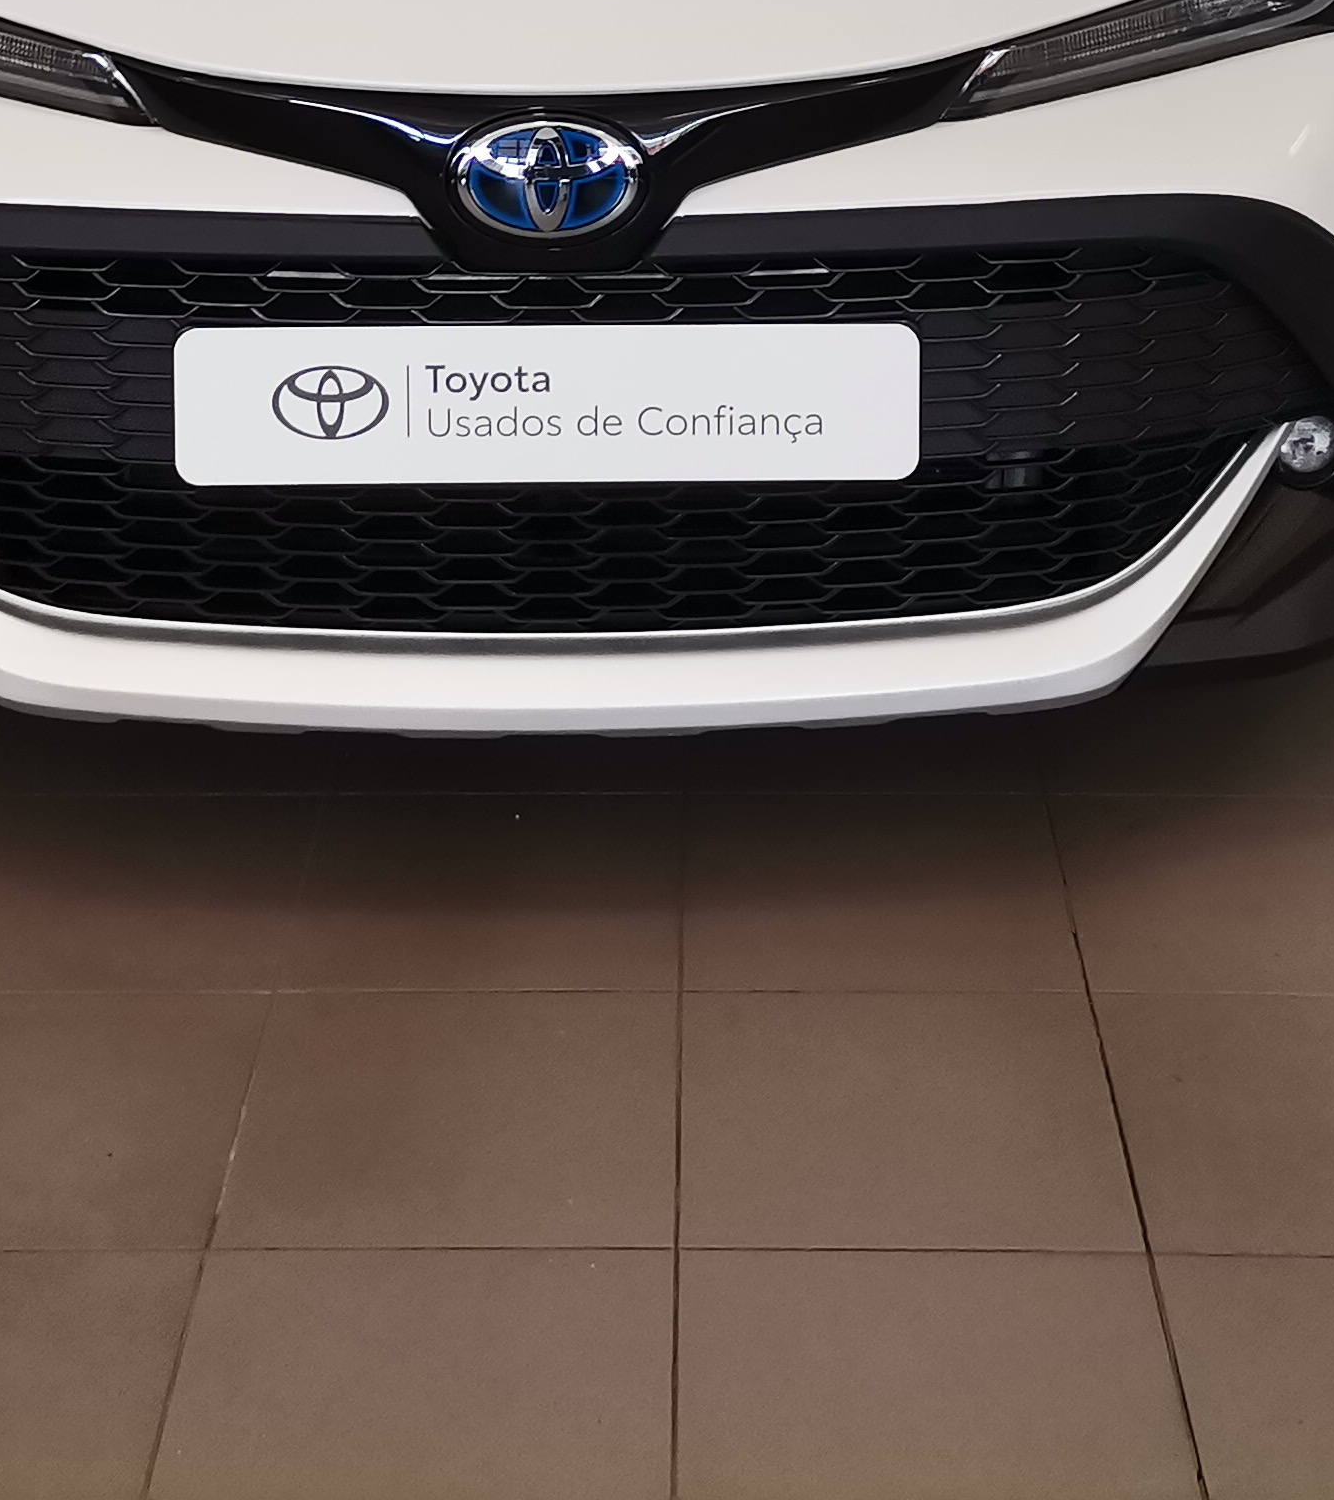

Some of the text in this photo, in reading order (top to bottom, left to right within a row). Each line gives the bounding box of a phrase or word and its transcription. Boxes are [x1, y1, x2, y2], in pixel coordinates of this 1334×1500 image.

[424, 364, 551, 401] Toyota
[426, 404, 825, 444] Usados de Confiança
